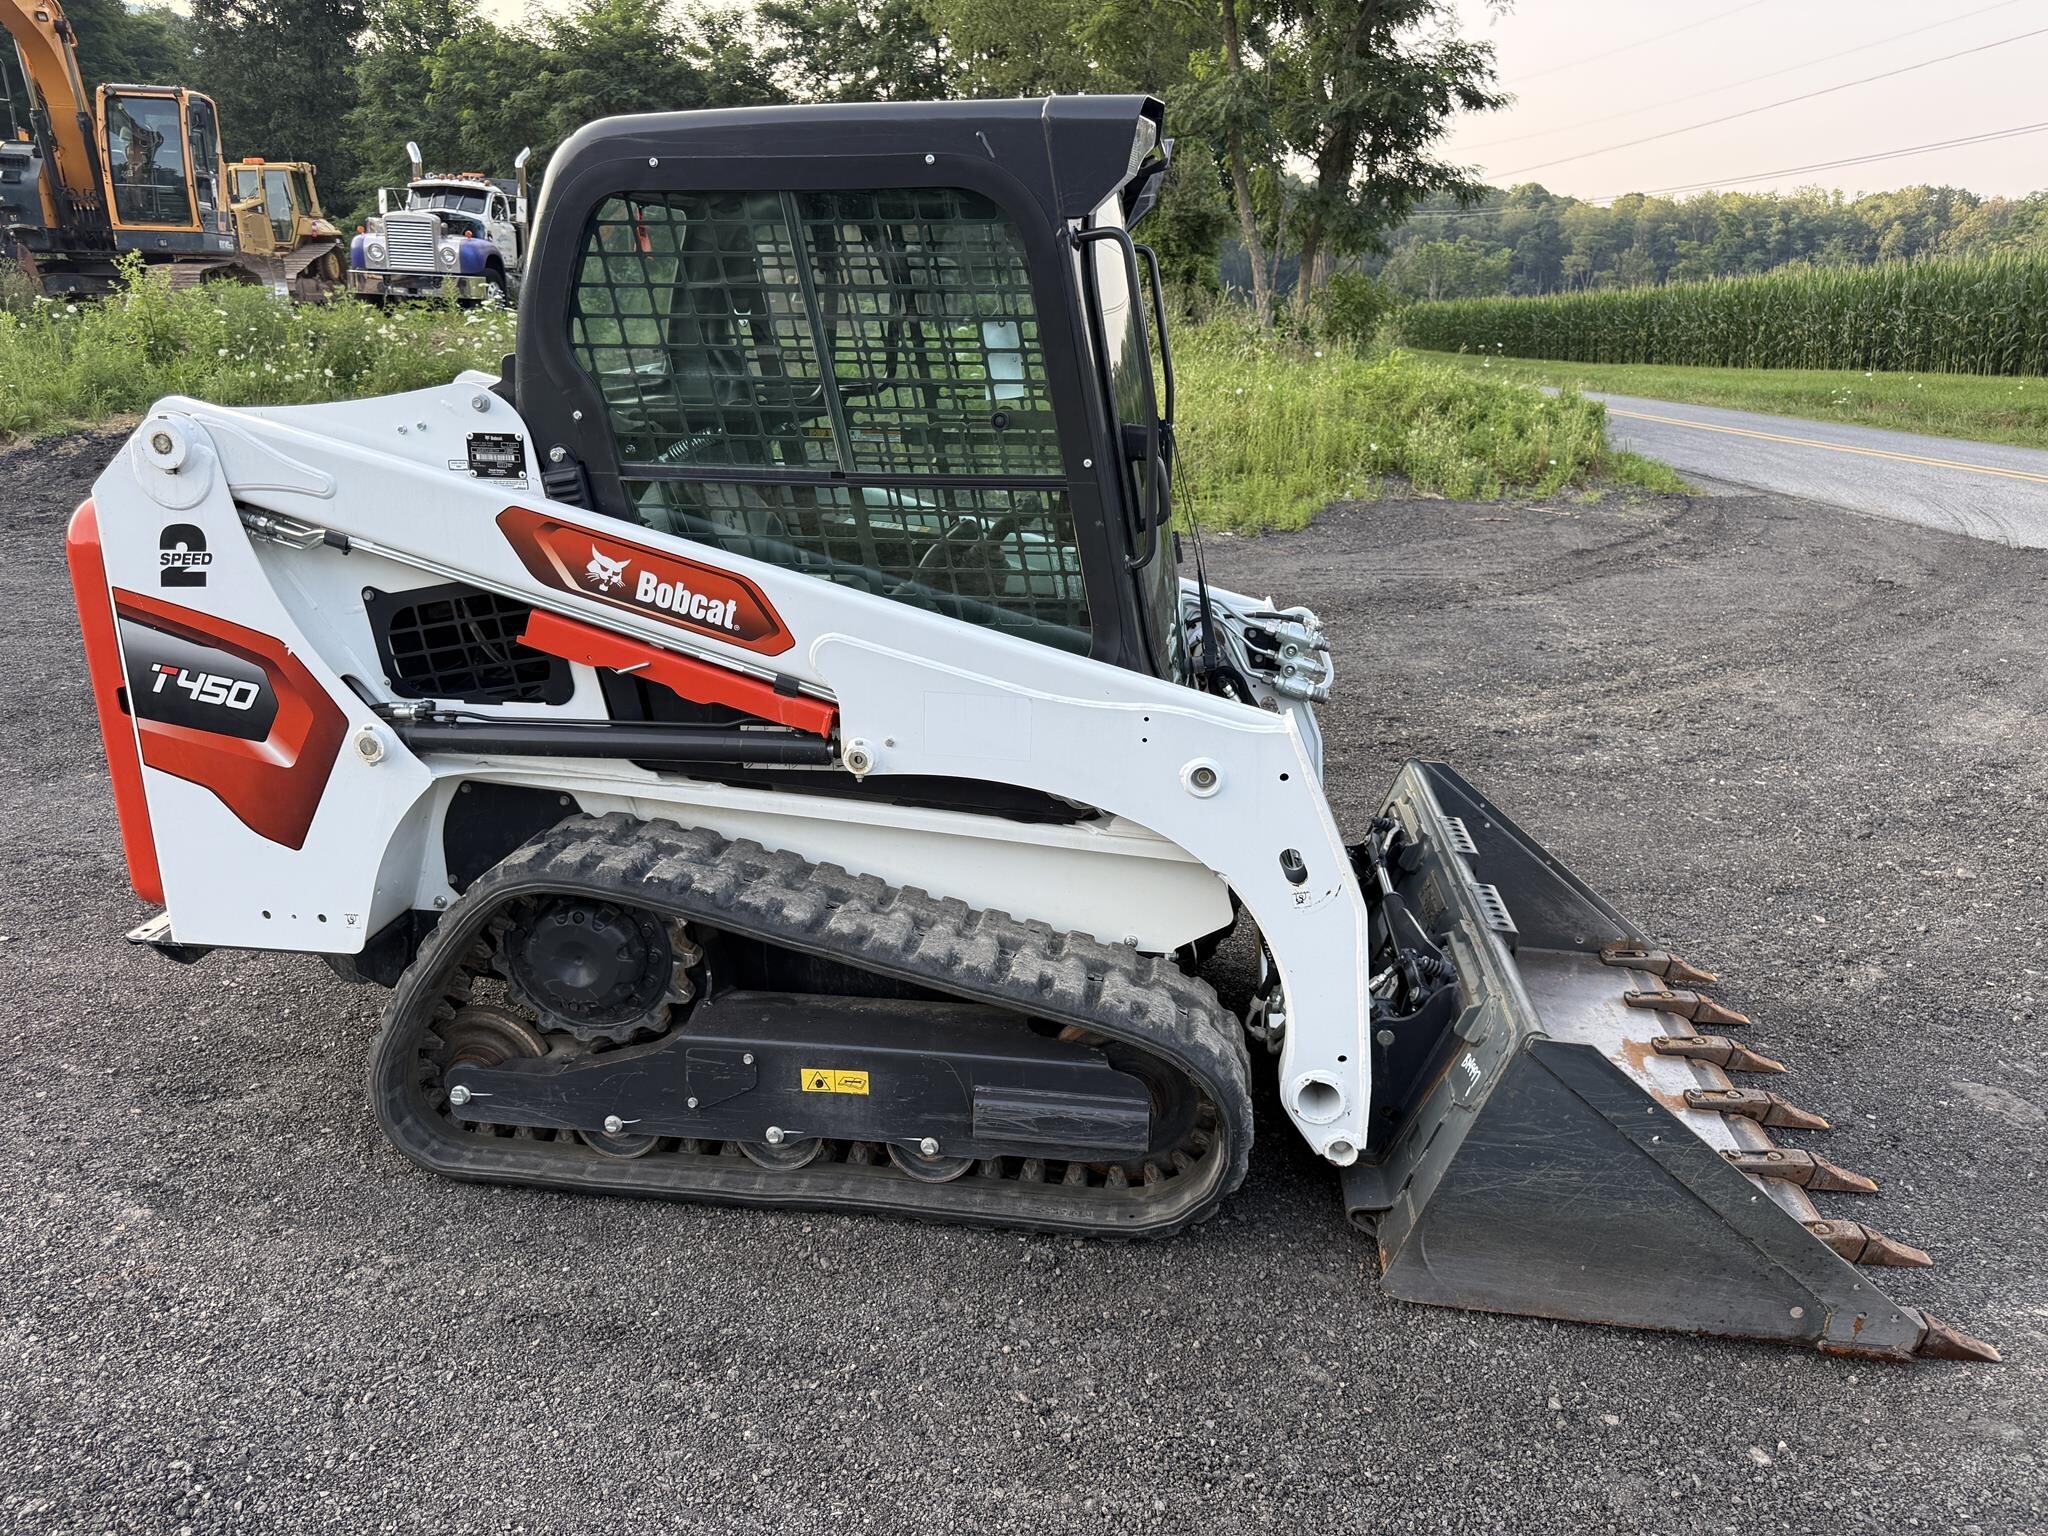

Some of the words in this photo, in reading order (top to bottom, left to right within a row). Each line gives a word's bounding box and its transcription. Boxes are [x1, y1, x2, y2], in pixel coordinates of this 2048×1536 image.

[159, 552, 213, 566] SPEED
[160, 523, 207, 587] 2
[151, 663, 260, 711] T450
